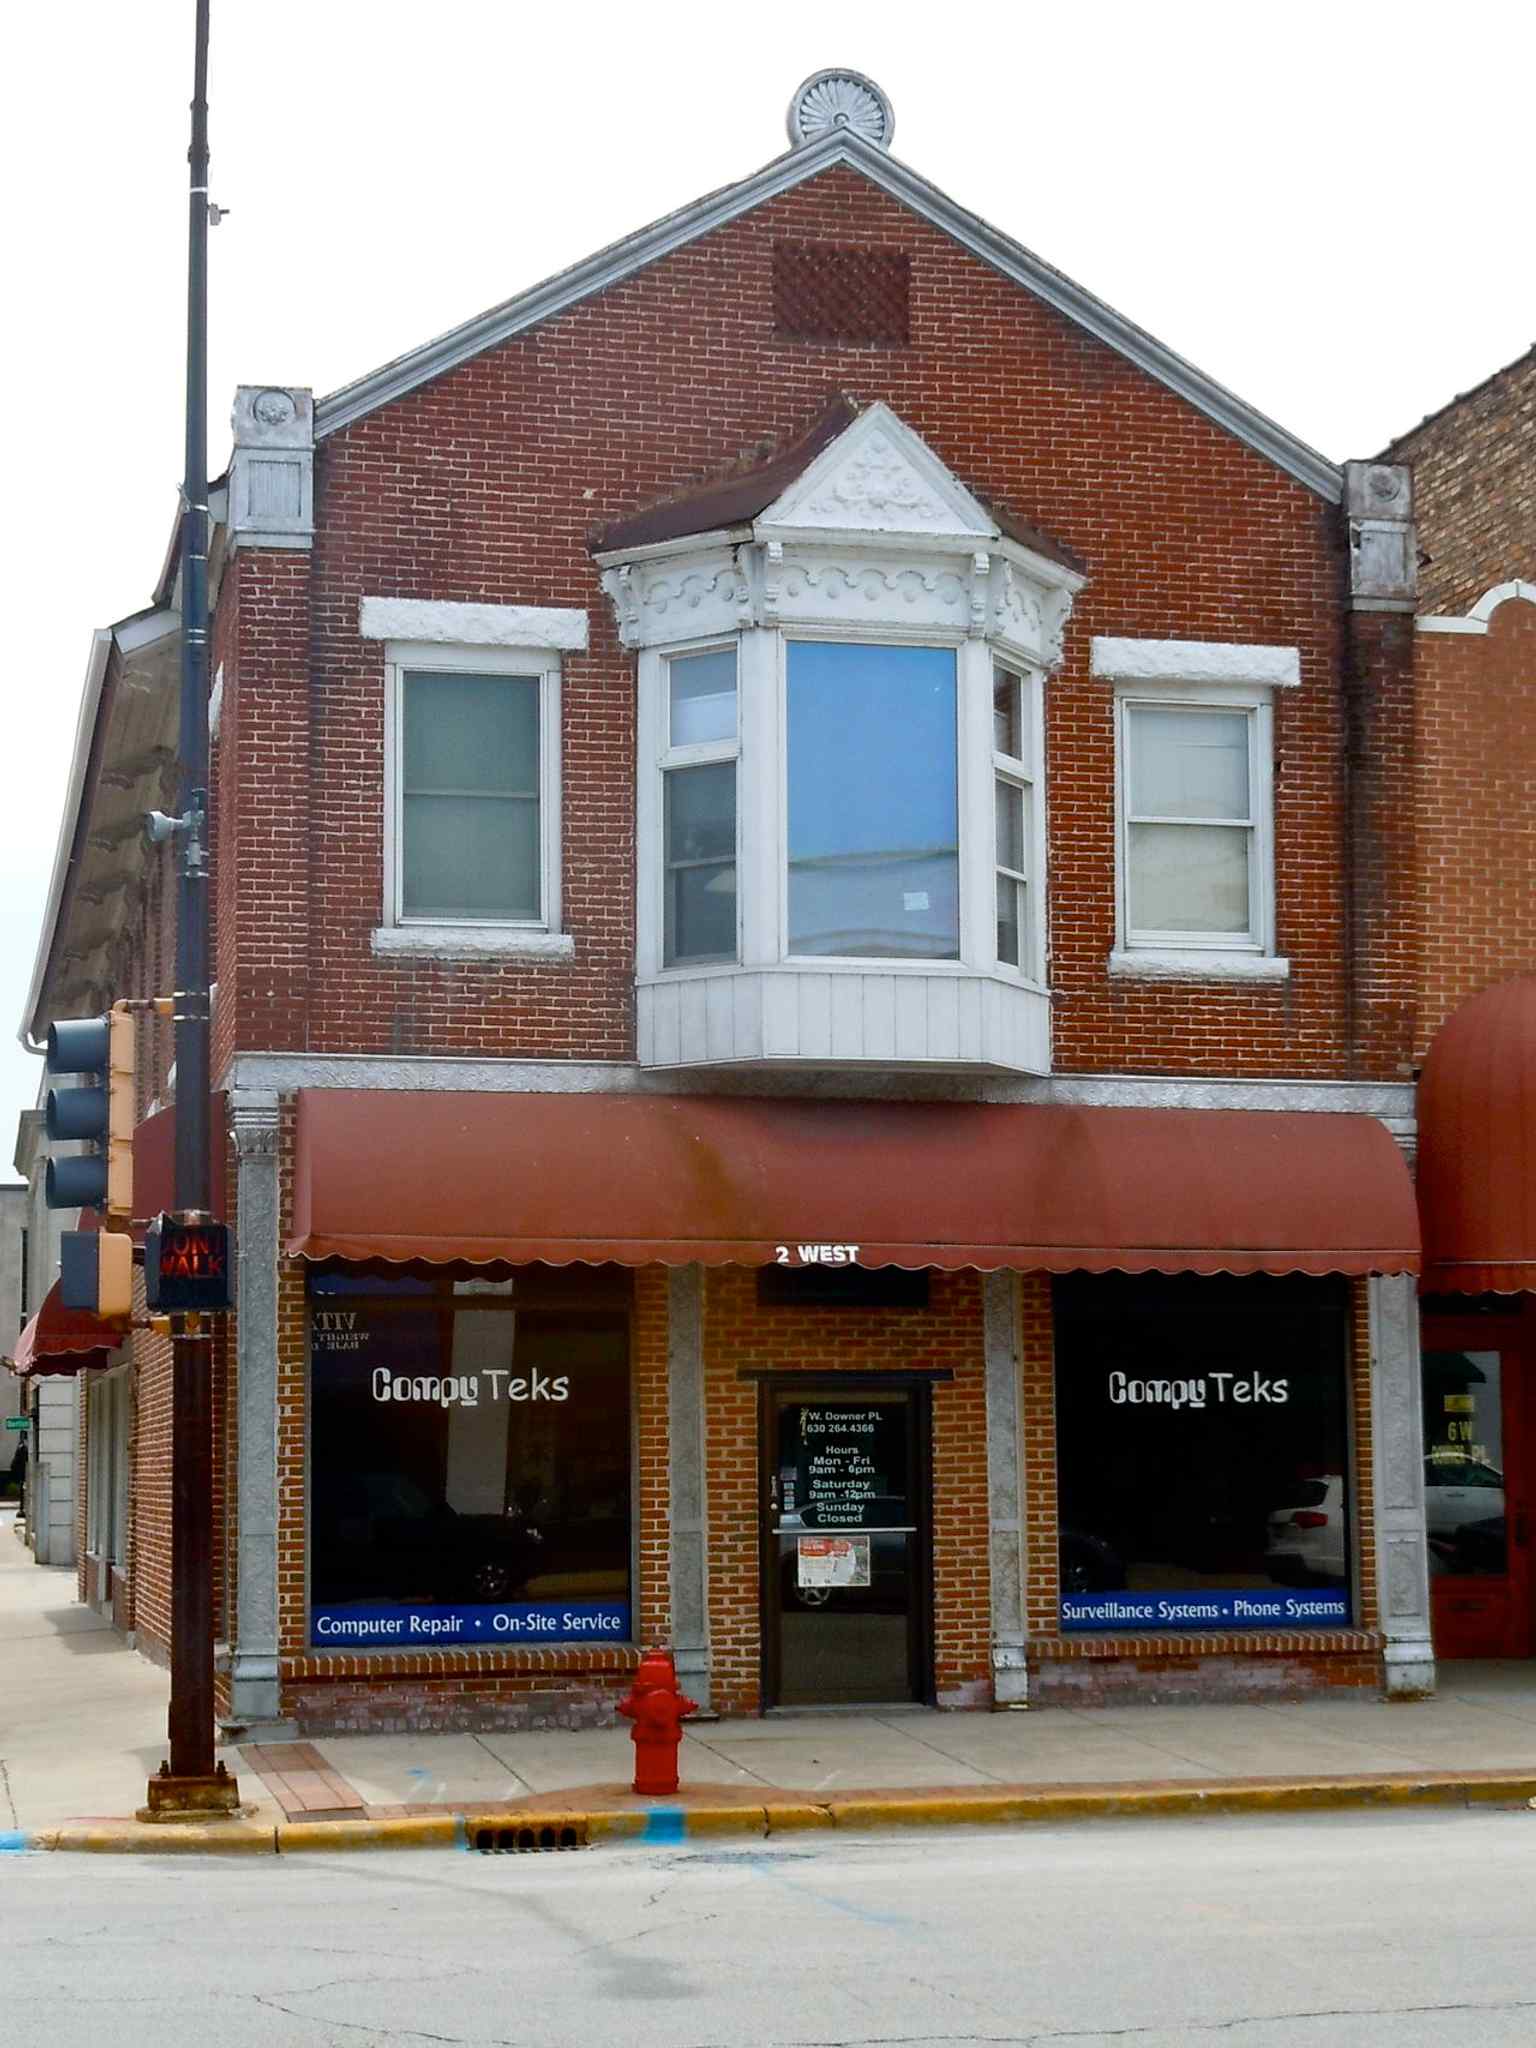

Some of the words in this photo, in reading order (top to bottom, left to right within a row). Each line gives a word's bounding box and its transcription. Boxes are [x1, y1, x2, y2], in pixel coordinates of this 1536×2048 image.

[775, 1246, 789, 1263] 2
[798, 1245, 859, 1262] WEST
[161, 1255, 224, 1278] WALK
[825, 1411, 866, 1421] Downer
[807, 1424, 826, 1433] 630
[825, 1445, 859, 1455] Hours
[813, 1456, 841, 1465] Mon
[853, 1456, 871, 1465] Fri
[808, 1465, 836, 1474] 9am
[812, 1480, 871, 1490] Saturday
[808, 1490, 836, 1499] 9am
[816, 1502, 865, 1512] Sunday
[817, 1513, 863, 1523] Closed
[1062, 1602, 1152, 1620] Surveillance
[1158, 1601, 1218, 1621] Systems
[1234, 1600, 1281, 1617] Phone
[1286, 1598, 1345, 1618] Systems
[317, 1616, 403, 1637] Computer
[409, 1615, 463, 1635] Repair
[493, 1613, 556, 1632] On-Site
[562, 1612, 621, 1631] Service
